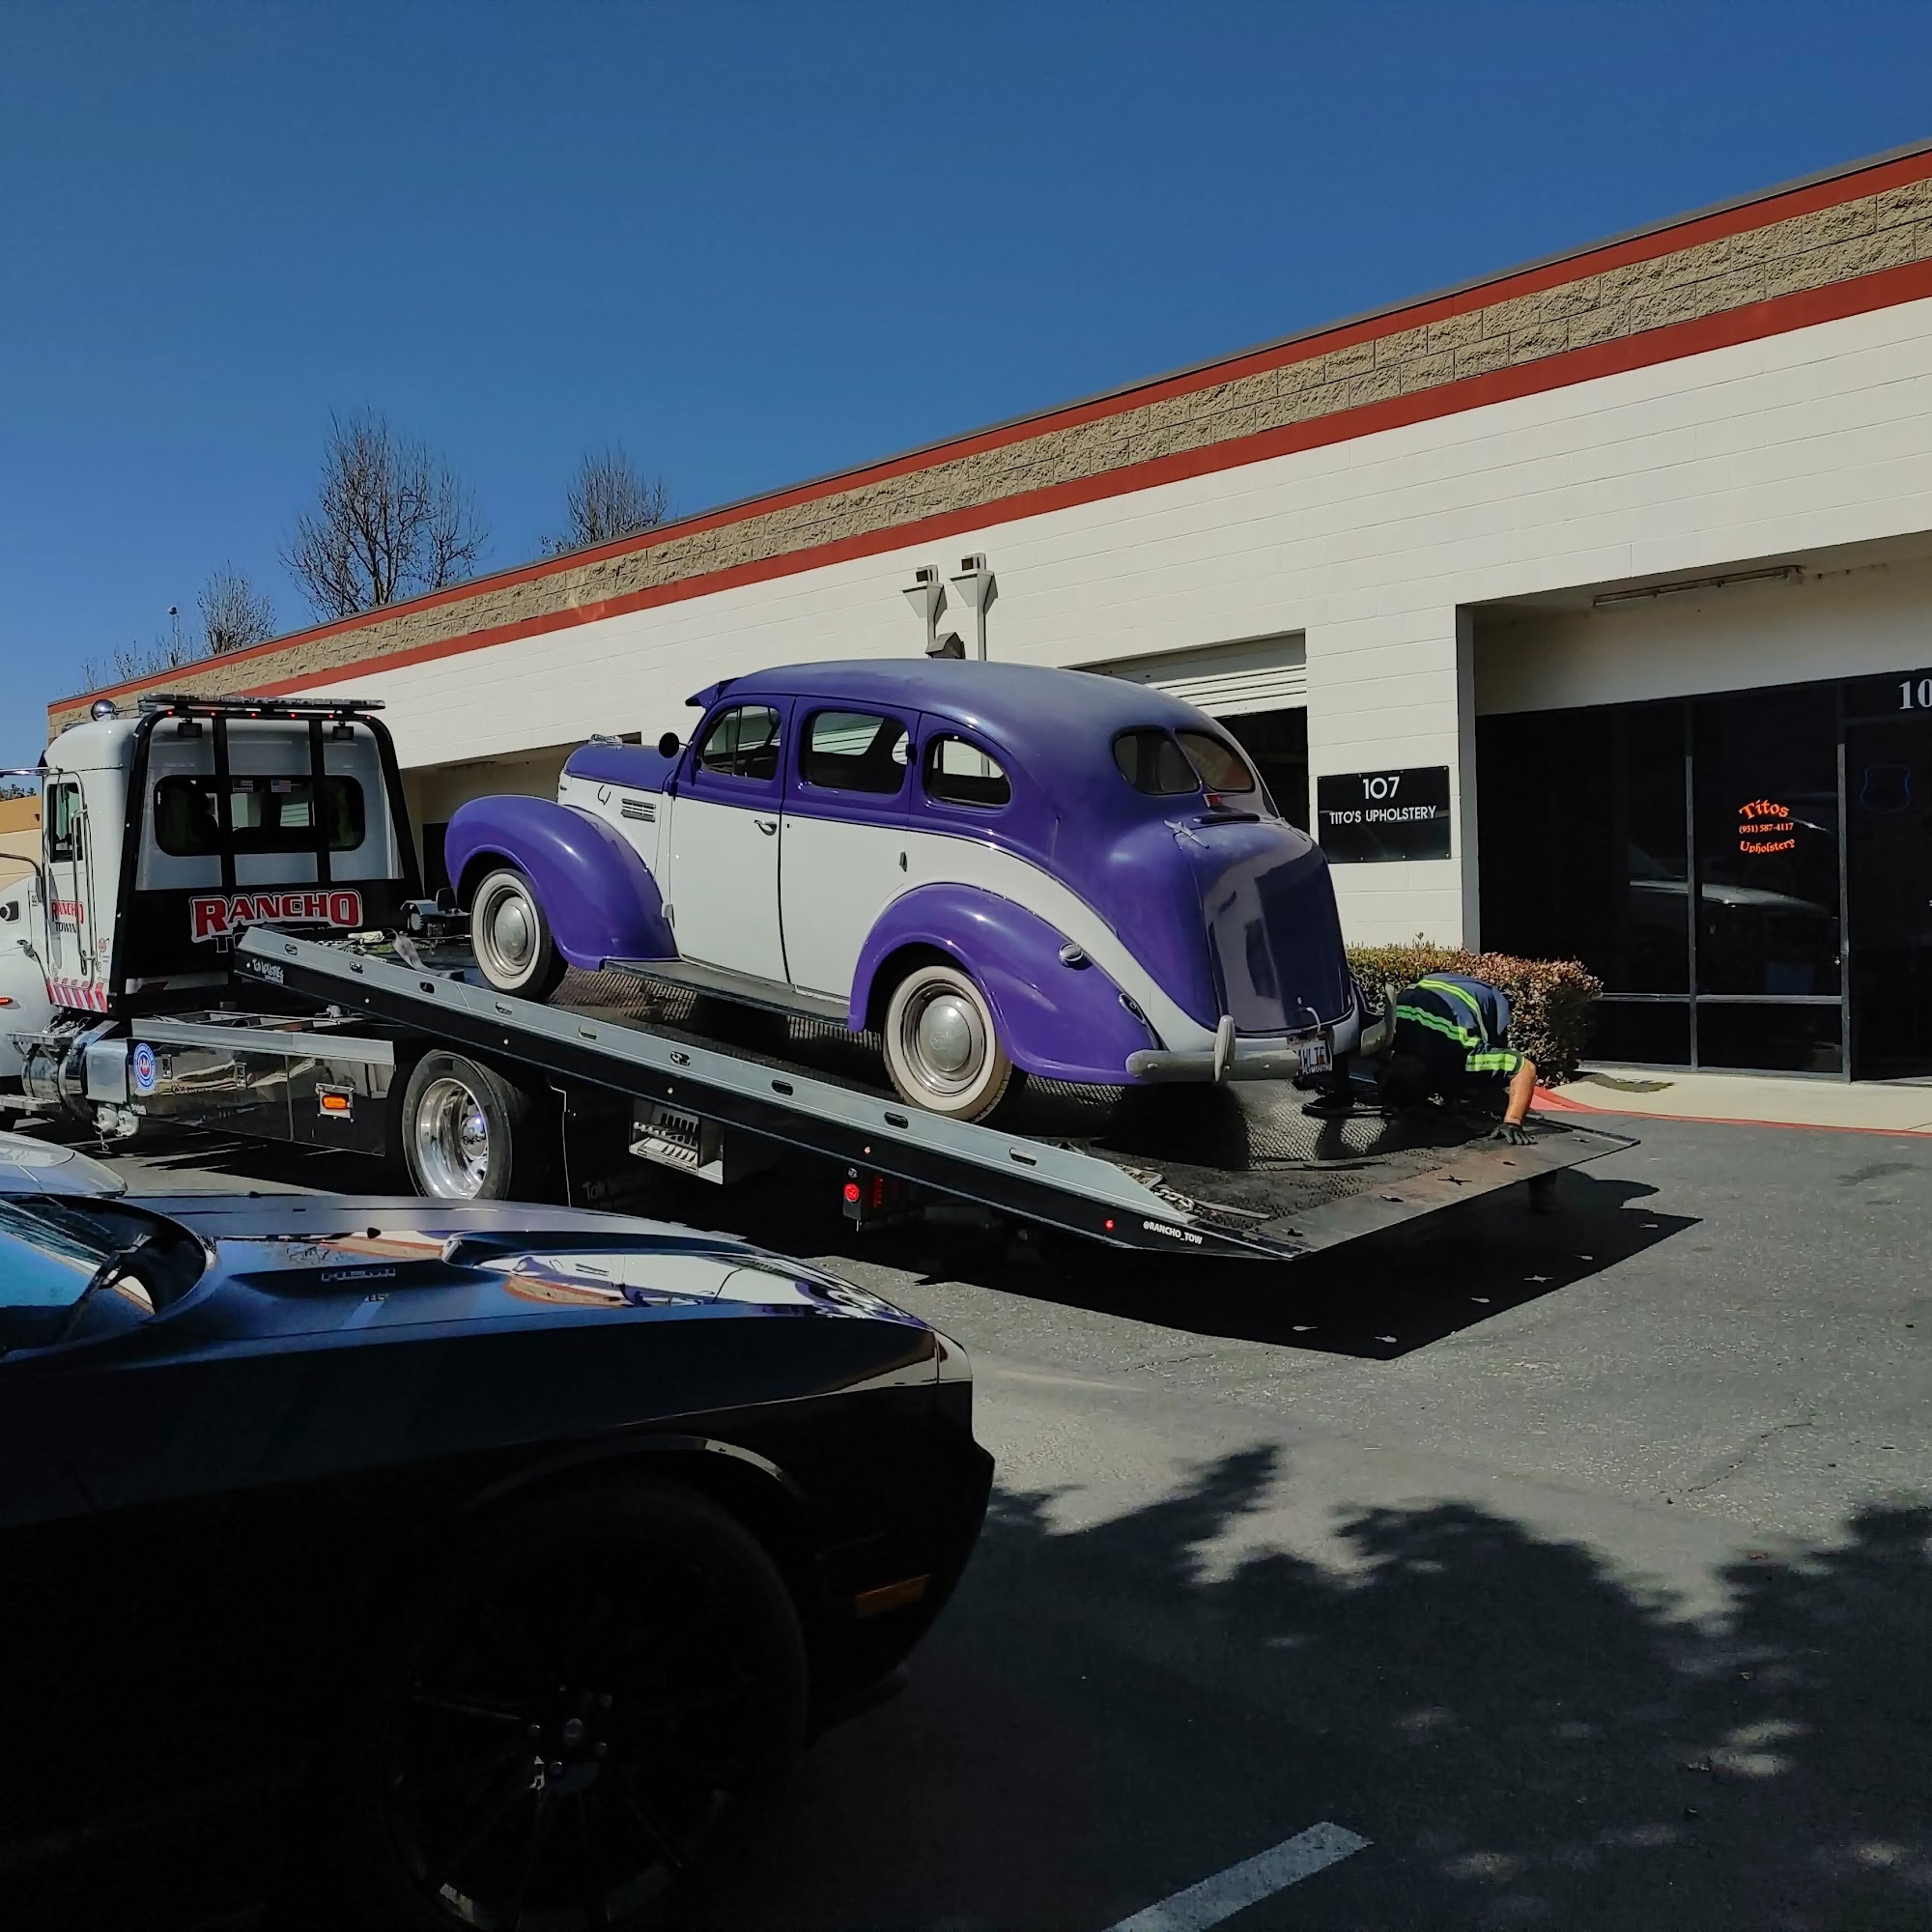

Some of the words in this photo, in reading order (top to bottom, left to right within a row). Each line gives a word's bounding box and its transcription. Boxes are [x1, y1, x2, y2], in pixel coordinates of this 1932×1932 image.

[1362, 776, 1400, 800] 107
[1329, 810, 1362, 825] TITO'S
[1365, 805, 1437, 823] UPHOLSTERY
[1739, 799, 1790, 820] Titos
[1739, 823, 1758, 835] (951)
[1759, 822, 1795, 833] 587-4117
[1740, 838, 1796, 854] Upholstery
[191, 890, 362, 942] RANCHO
[55, 922, 77, 934] TOWIN
[1143, 1221, 1204, 1245] @RANCHO_TOW
